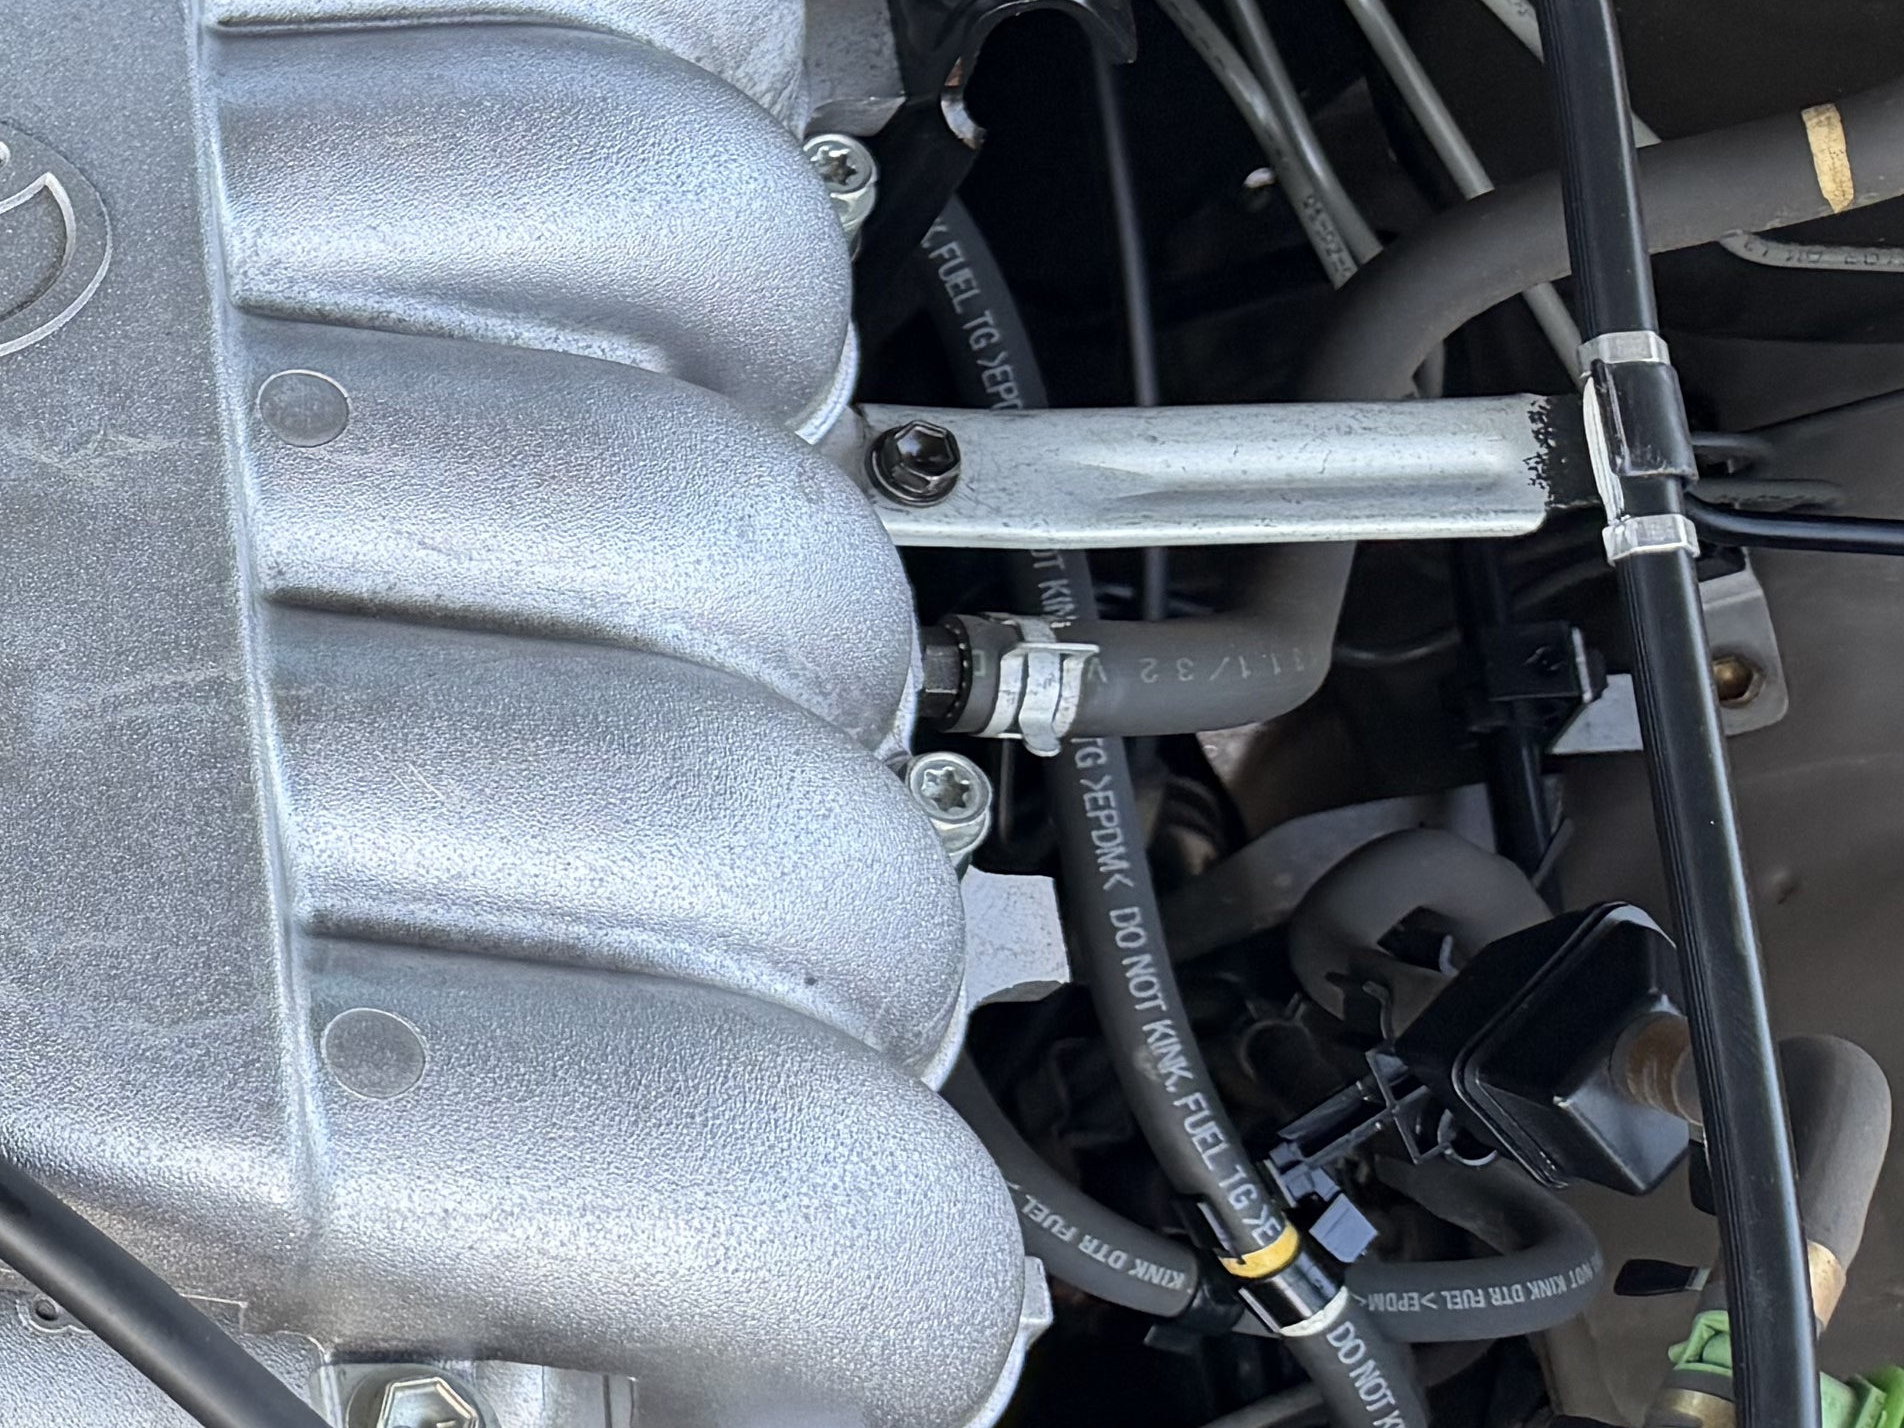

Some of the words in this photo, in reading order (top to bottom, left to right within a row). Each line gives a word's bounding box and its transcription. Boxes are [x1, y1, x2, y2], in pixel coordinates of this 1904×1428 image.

[928, 241, 982, 314] FUEL
[961, 309, 1000, 351] TG
[1109, 905, 1145, 949] DO
[1121, 954, 1166, 1011] NOT
[1174, 1092, 1229, 1171] FUEL
[1021, 1193, 1078, 1242] FUEL
[1129, 1256, 1185, 1293] KINK
[1443, 1289, 1486, 1309] FUEL
[1526, 1275, 1565, 1301] KINK
[1326, 1320, 1366, 1364] DO
[1349, 1358, 1395, 1413] NOT
